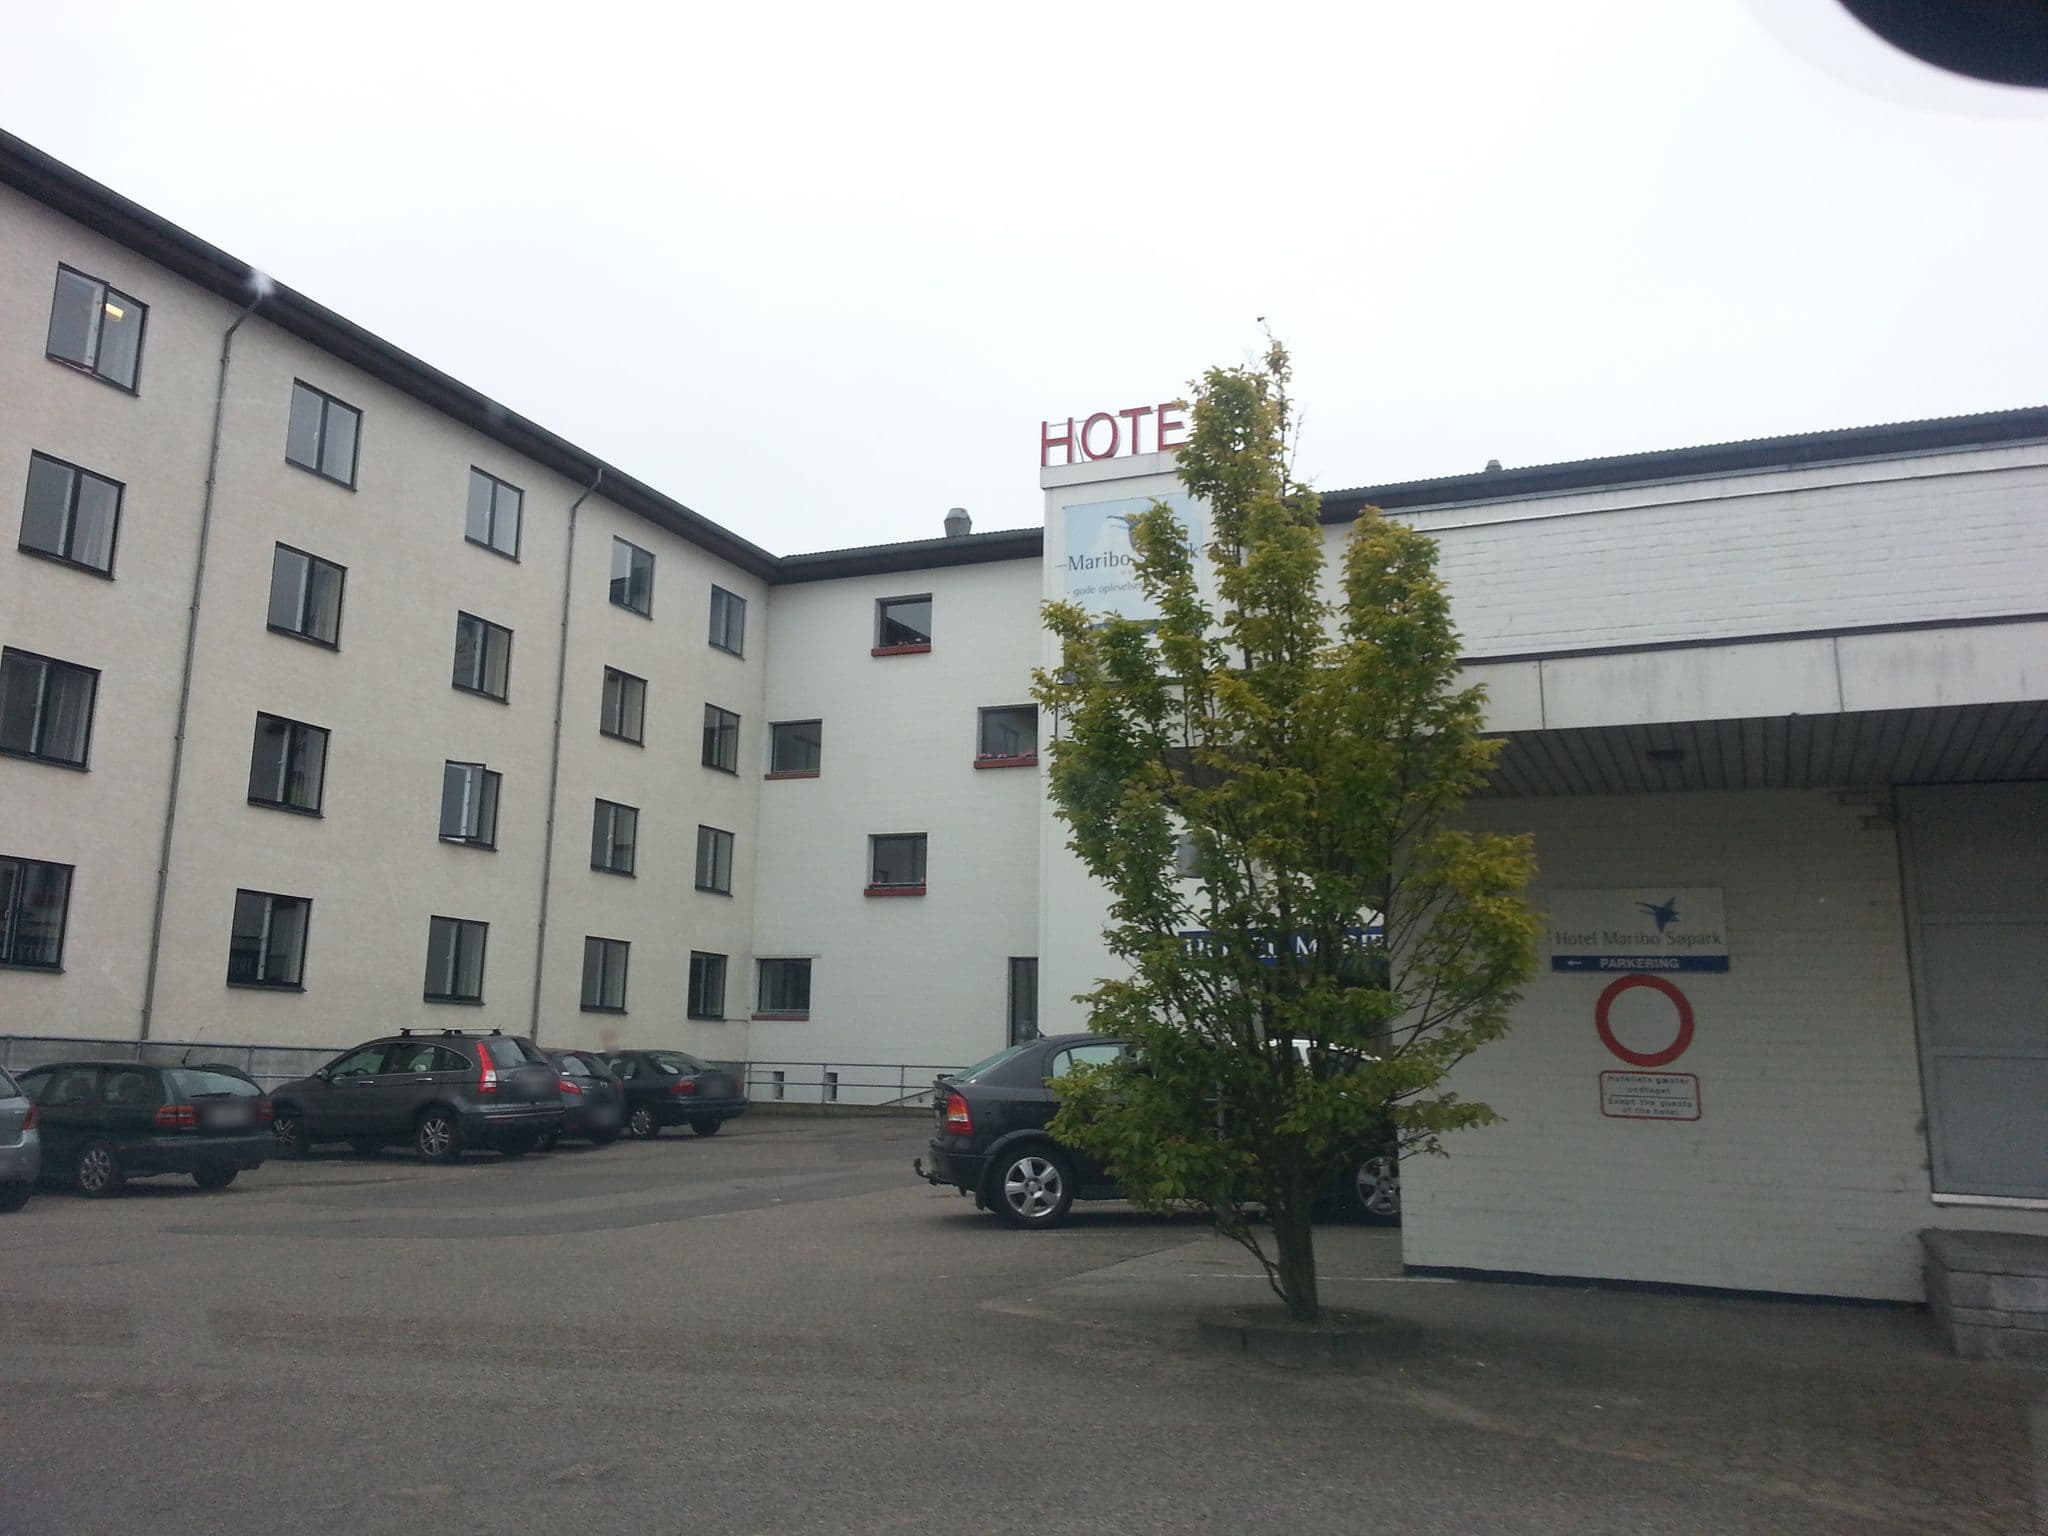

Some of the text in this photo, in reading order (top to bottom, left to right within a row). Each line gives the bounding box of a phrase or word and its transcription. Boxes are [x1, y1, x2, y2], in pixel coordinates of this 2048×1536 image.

[1041, 402, 1191, 467] HOTE
[1068, 551, 1130, 571] Maribo
[1555, 931, 1597, 946] Hotel
[1603, 931, 1660, 946] Maribo
[1600, 957, 1680, 969] PARKERING
